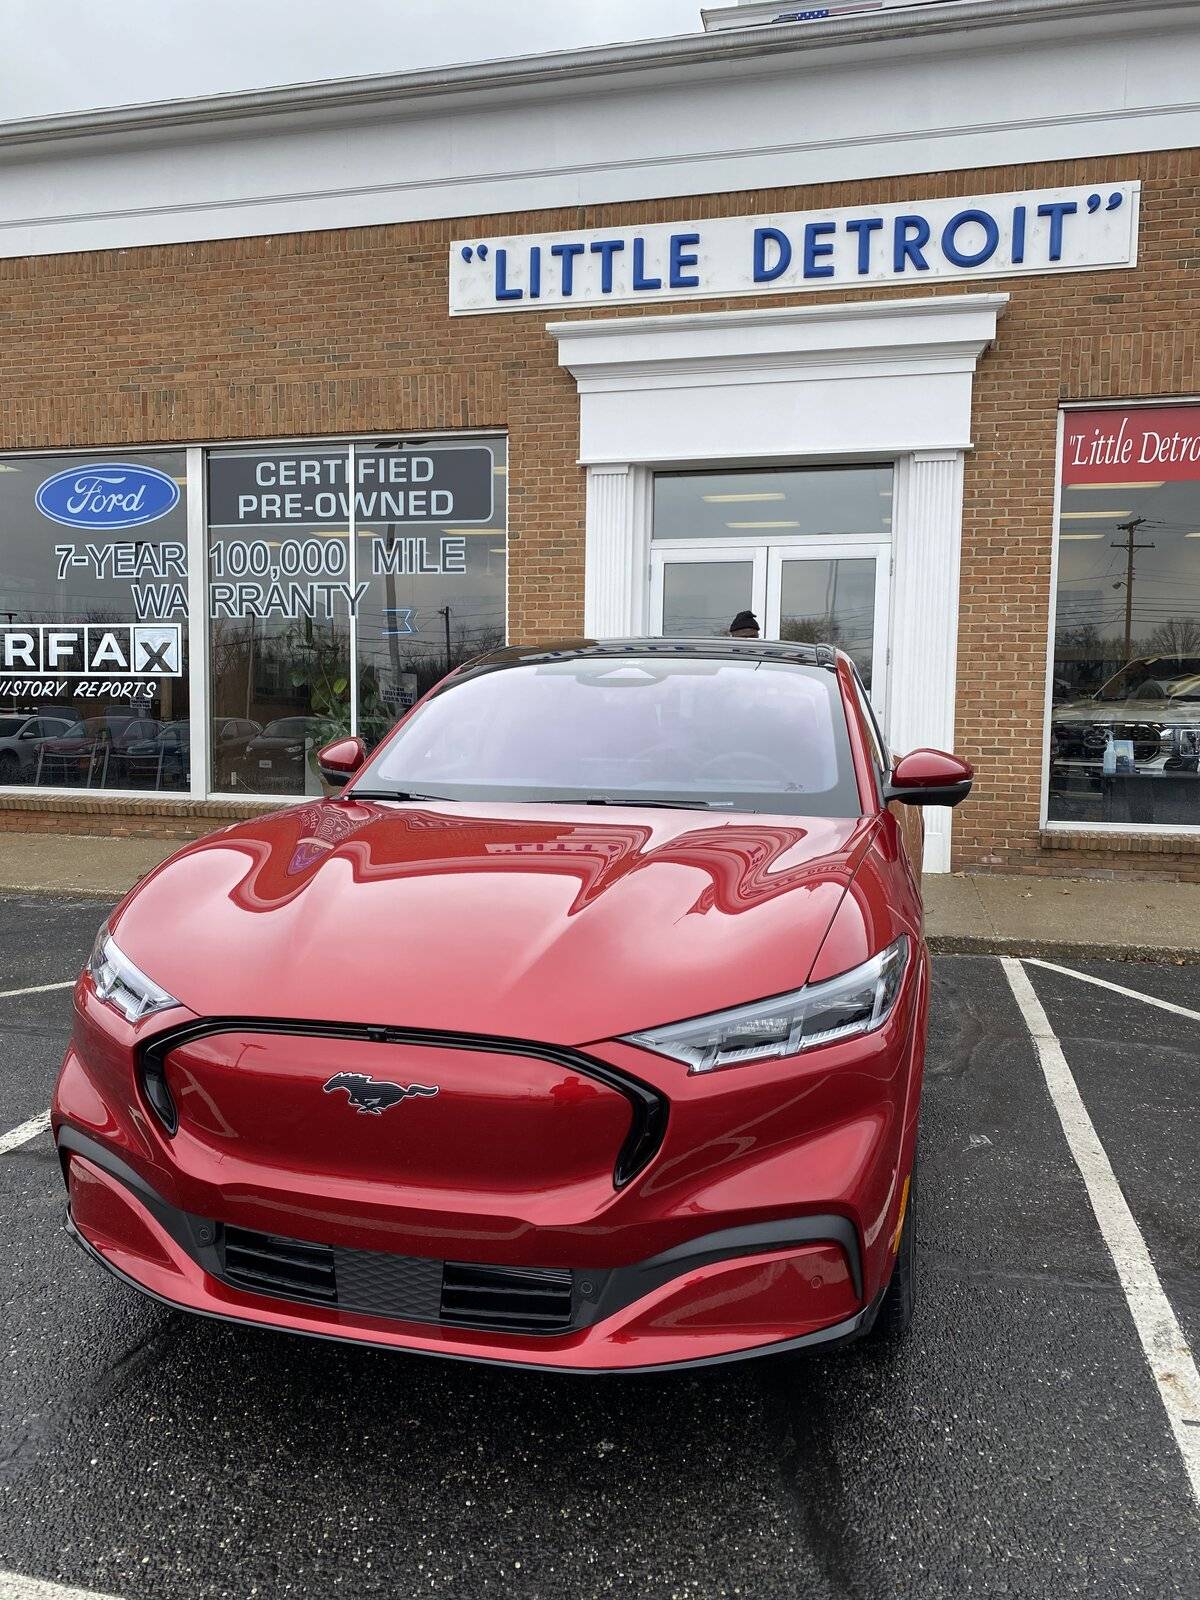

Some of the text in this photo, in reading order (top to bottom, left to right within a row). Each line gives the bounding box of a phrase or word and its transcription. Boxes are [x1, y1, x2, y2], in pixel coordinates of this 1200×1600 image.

[1069, 417, 1133, 466] "Little
[256, 456, 435, 487] CERTIFIED
[66, 476, 147, 514] Ford
[238, 490, 454, 519] PRE-OWNED
[54, 536, 467, 582] 7-YEAR 100,000 MILE
[131, 581, 370, 619] WARRANTY
[73, 681, 157, 698] REPORTS
